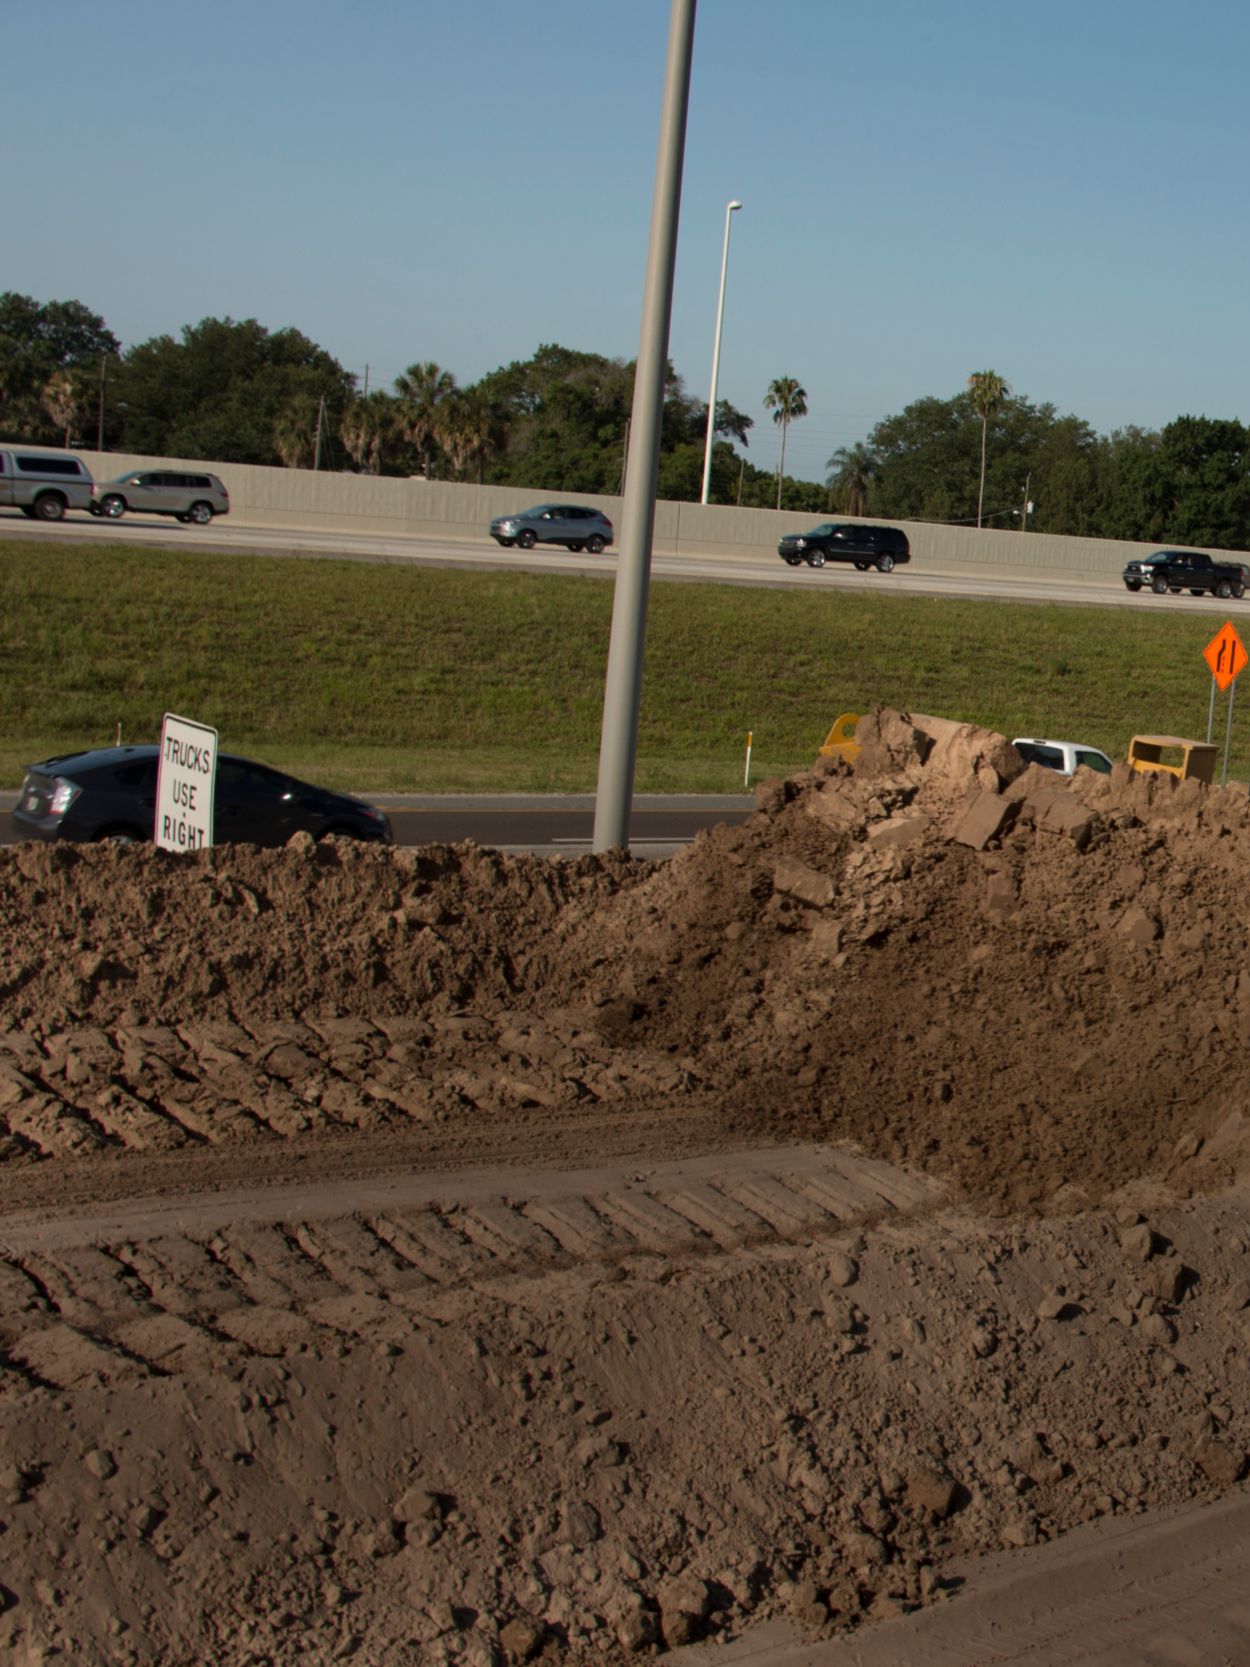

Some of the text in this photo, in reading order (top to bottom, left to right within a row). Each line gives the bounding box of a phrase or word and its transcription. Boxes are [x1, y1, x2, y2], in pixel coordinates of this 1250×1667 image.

[166, 736, 210, 774] TRUCKS
[172, 779, 197, 811] USE
[163, 815, 205, 851] RIGHT
